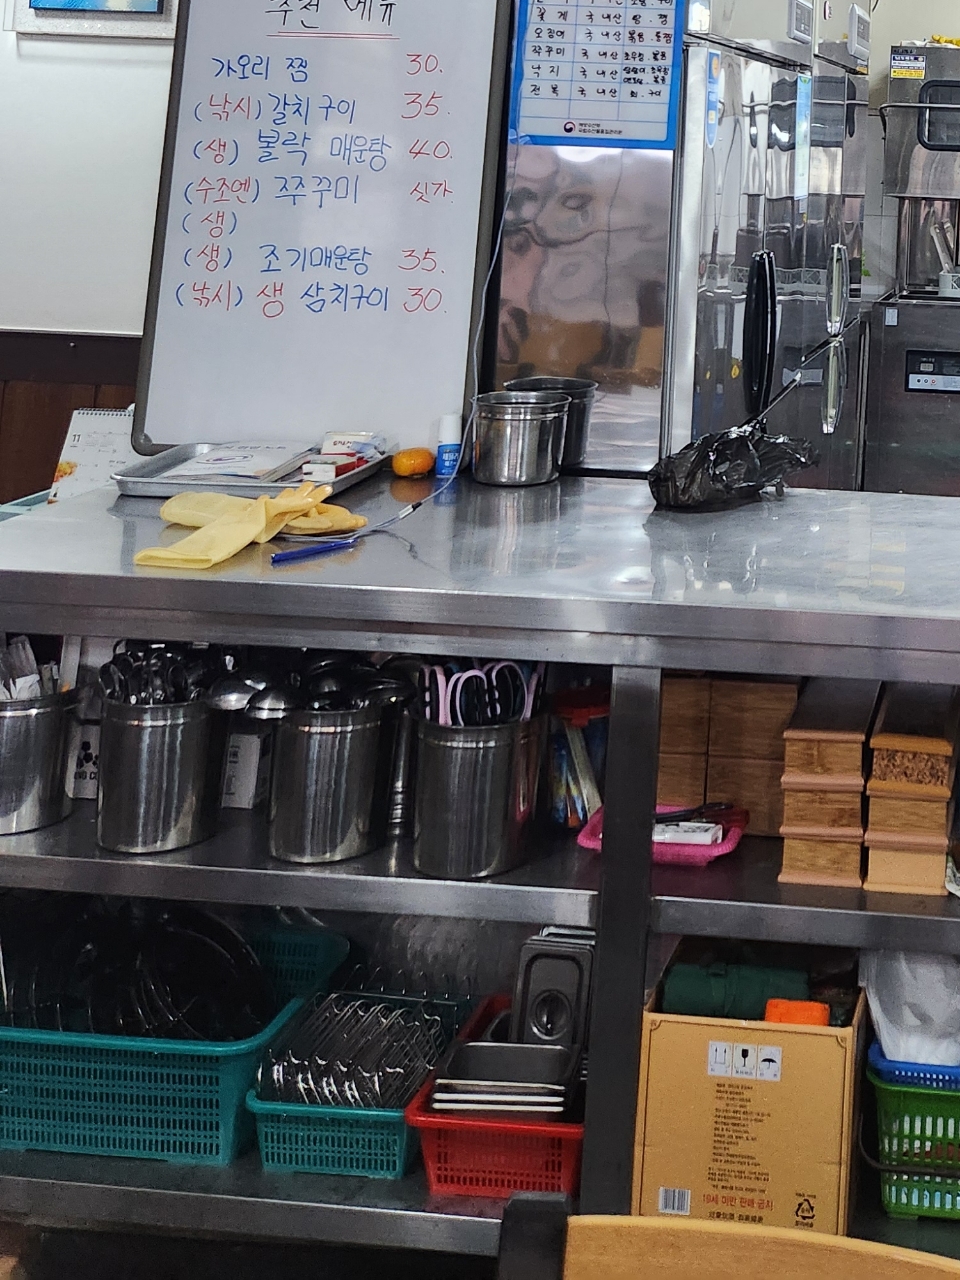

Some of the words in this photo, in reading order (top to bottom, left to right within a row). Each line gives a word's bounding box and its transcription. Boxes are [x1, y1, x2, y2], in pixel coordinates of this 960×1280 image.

[211, 55, 270, 80] 가오리
[286, 57, 308, 83] 찜
[195, 93, 262, 122] (낚시)
[193, 138, 239, 166] (생)
[258, 129, 312, 166] 볼락
[330, 134, 392, 172] 매운탕
[274, 175, 359, 209] 쭈꾸미
[182, 211, 238, 238] (생)
[184, 243, 232, 272] (생)
[175, 280, 243, 312] (낚시)
[256, 282, 284, 318] 생
[300, 281, 389, 314] 삼치구이
